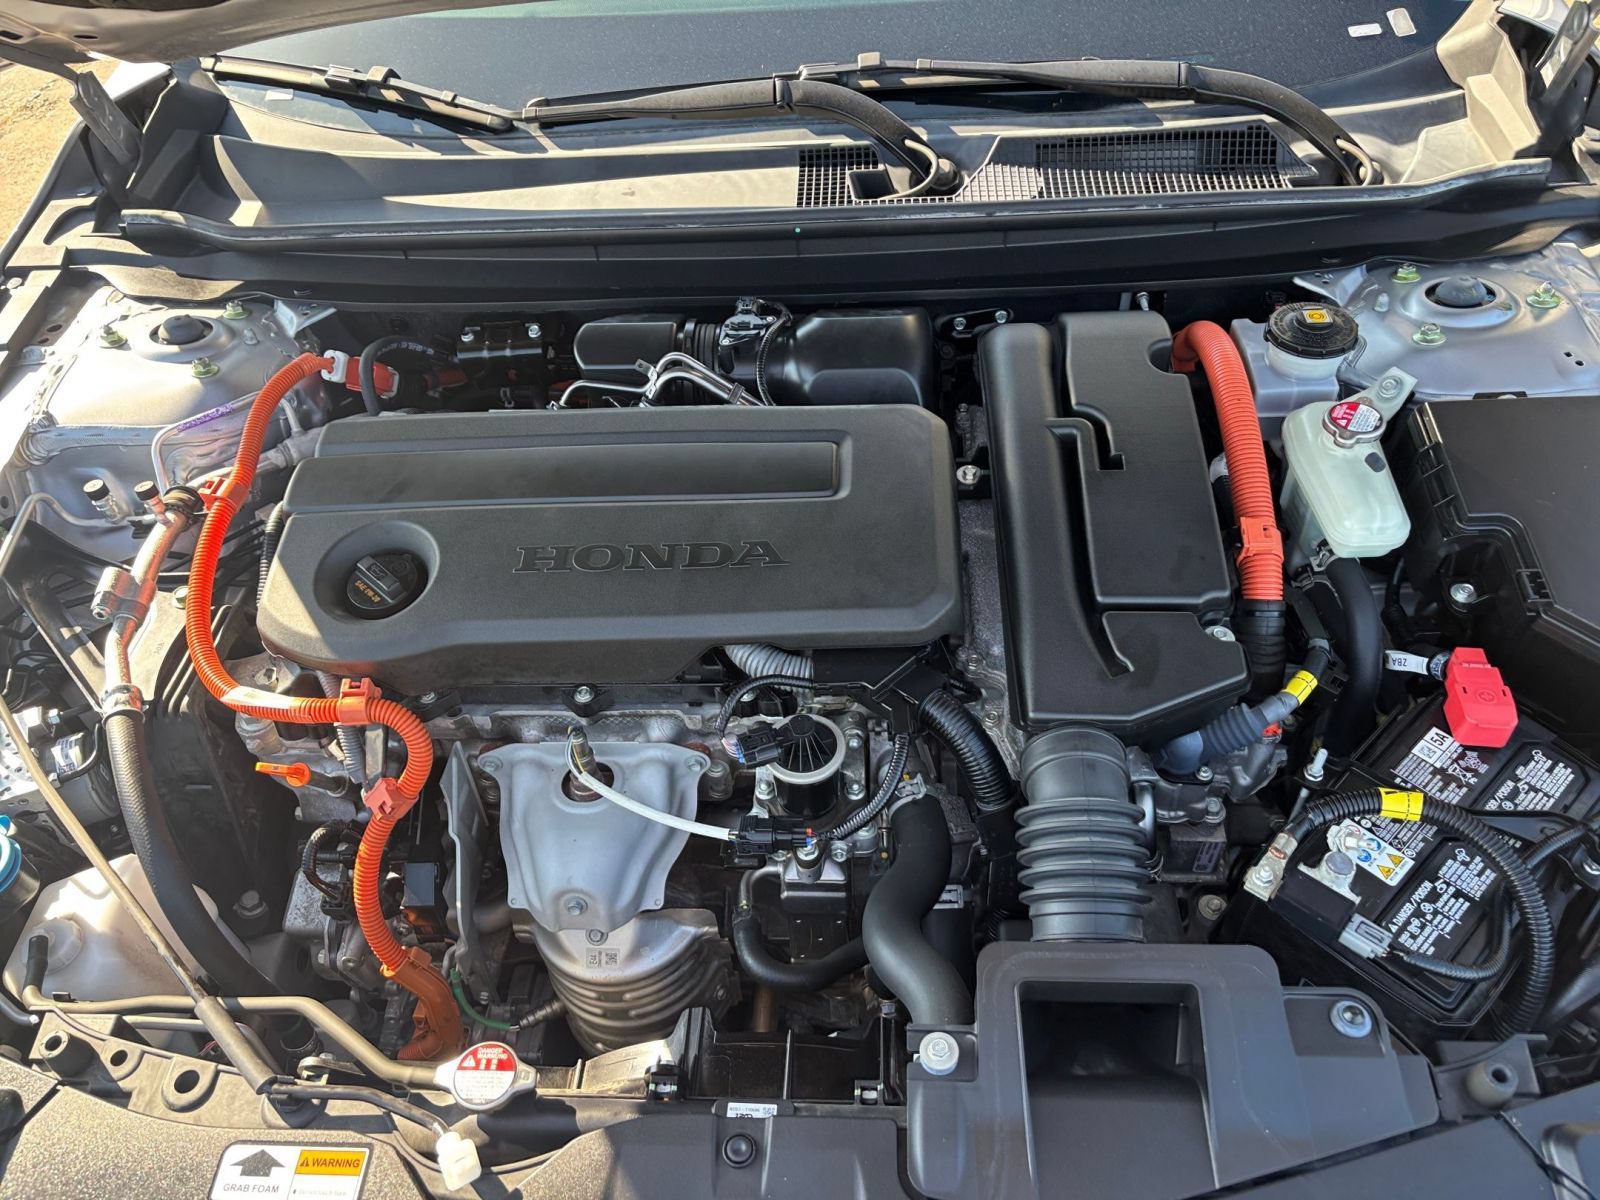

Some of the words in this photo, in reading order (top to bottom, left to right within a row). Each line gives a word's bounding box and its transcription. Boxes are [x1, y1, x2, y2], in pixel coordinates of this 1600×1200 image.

[513, 540, 791, 573] HONDA
[1391, 658, 1407, 666] ZBA
[1430, 731, 1449, 746] 5A
[312, 1158, 360, 1168] WARNING
[251, 1184, 280, 1193] FOAM
